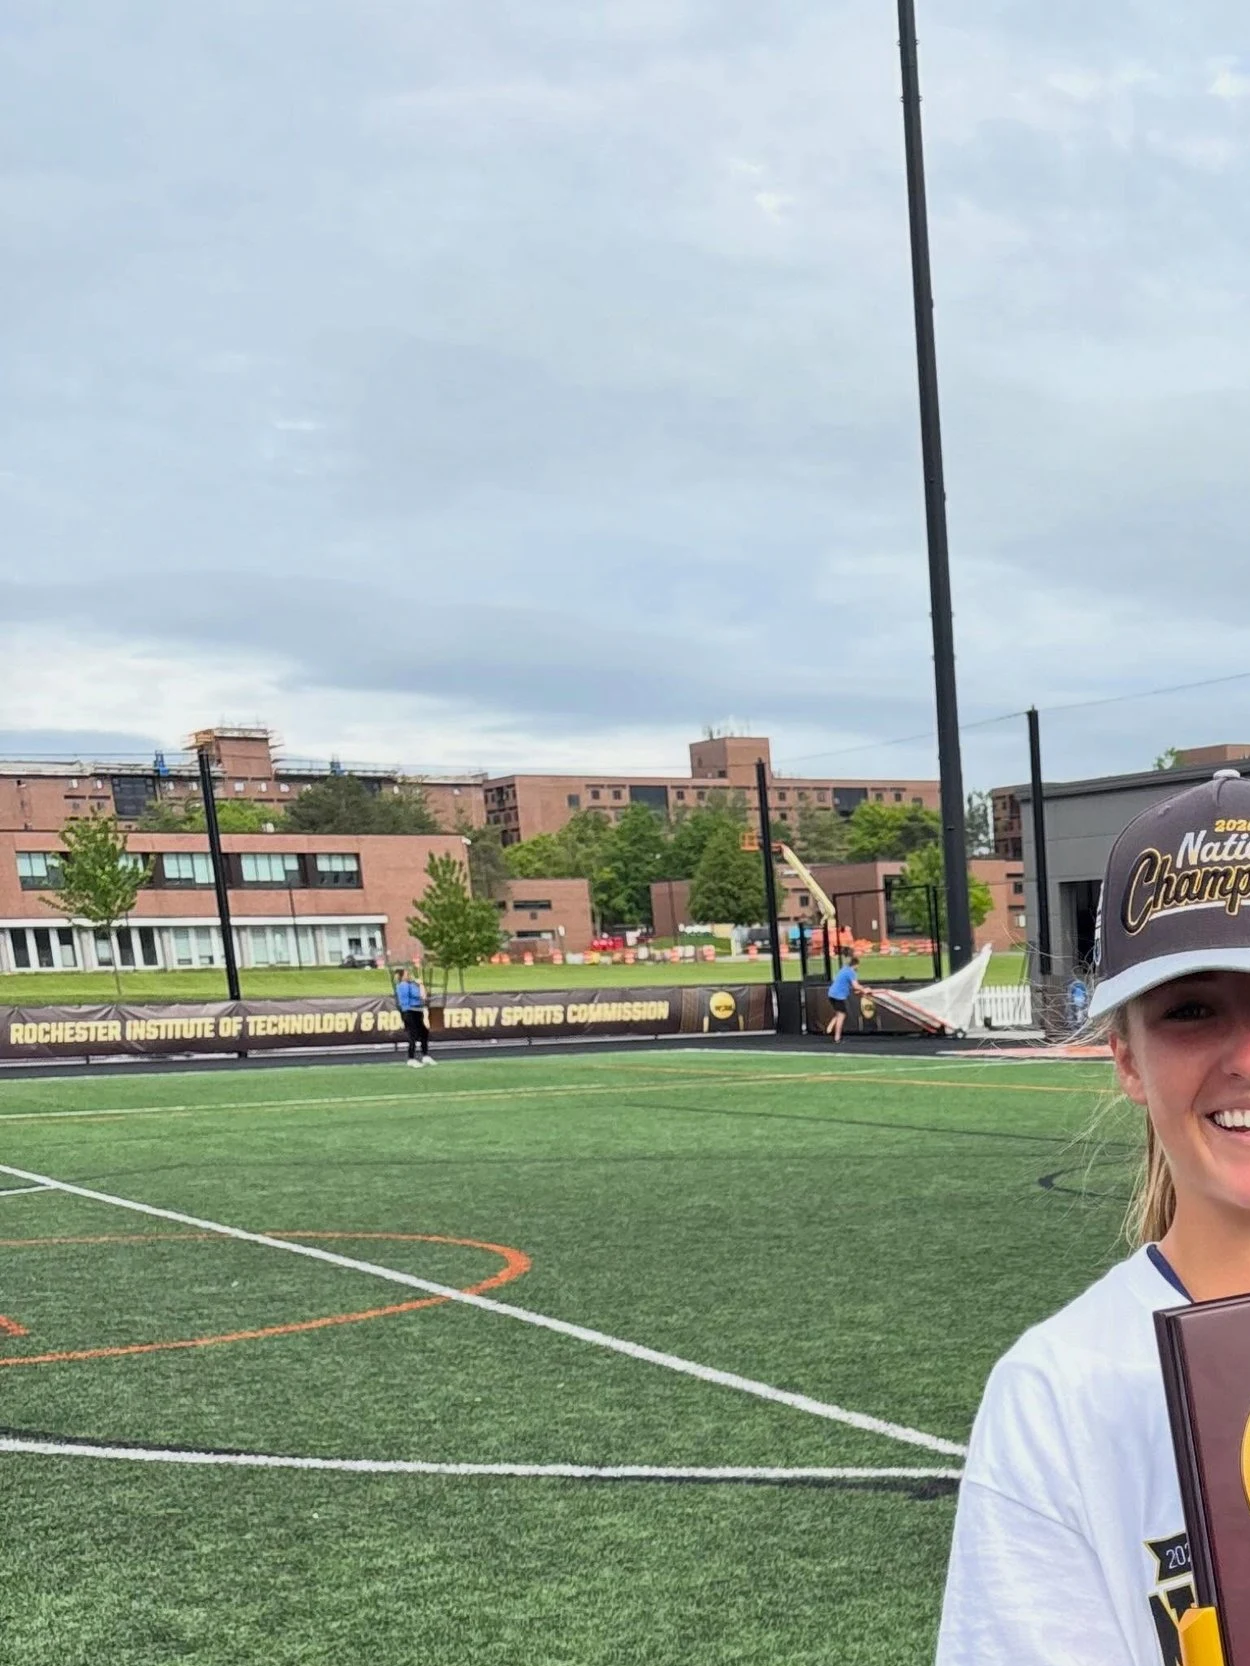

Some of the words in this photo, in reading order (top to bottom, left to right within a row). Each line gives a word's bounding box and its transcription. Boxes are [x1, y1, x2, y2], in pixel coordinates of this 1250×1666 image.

[10, 1020, 122, 1045] ROCHESTER
[126, 1017, 216, 1040] INSTITUTE
[219, 1016, 243, 1037] OF
[247, 1011, 358, 1036] TECHNOLOGY
[360, 1012, 375, 1032] &
[475, 1006, 499, 1028] NY
[501, 1003, 565, 1027] SPORTS
[566, 1000, 670, 1023] COMMISSION
